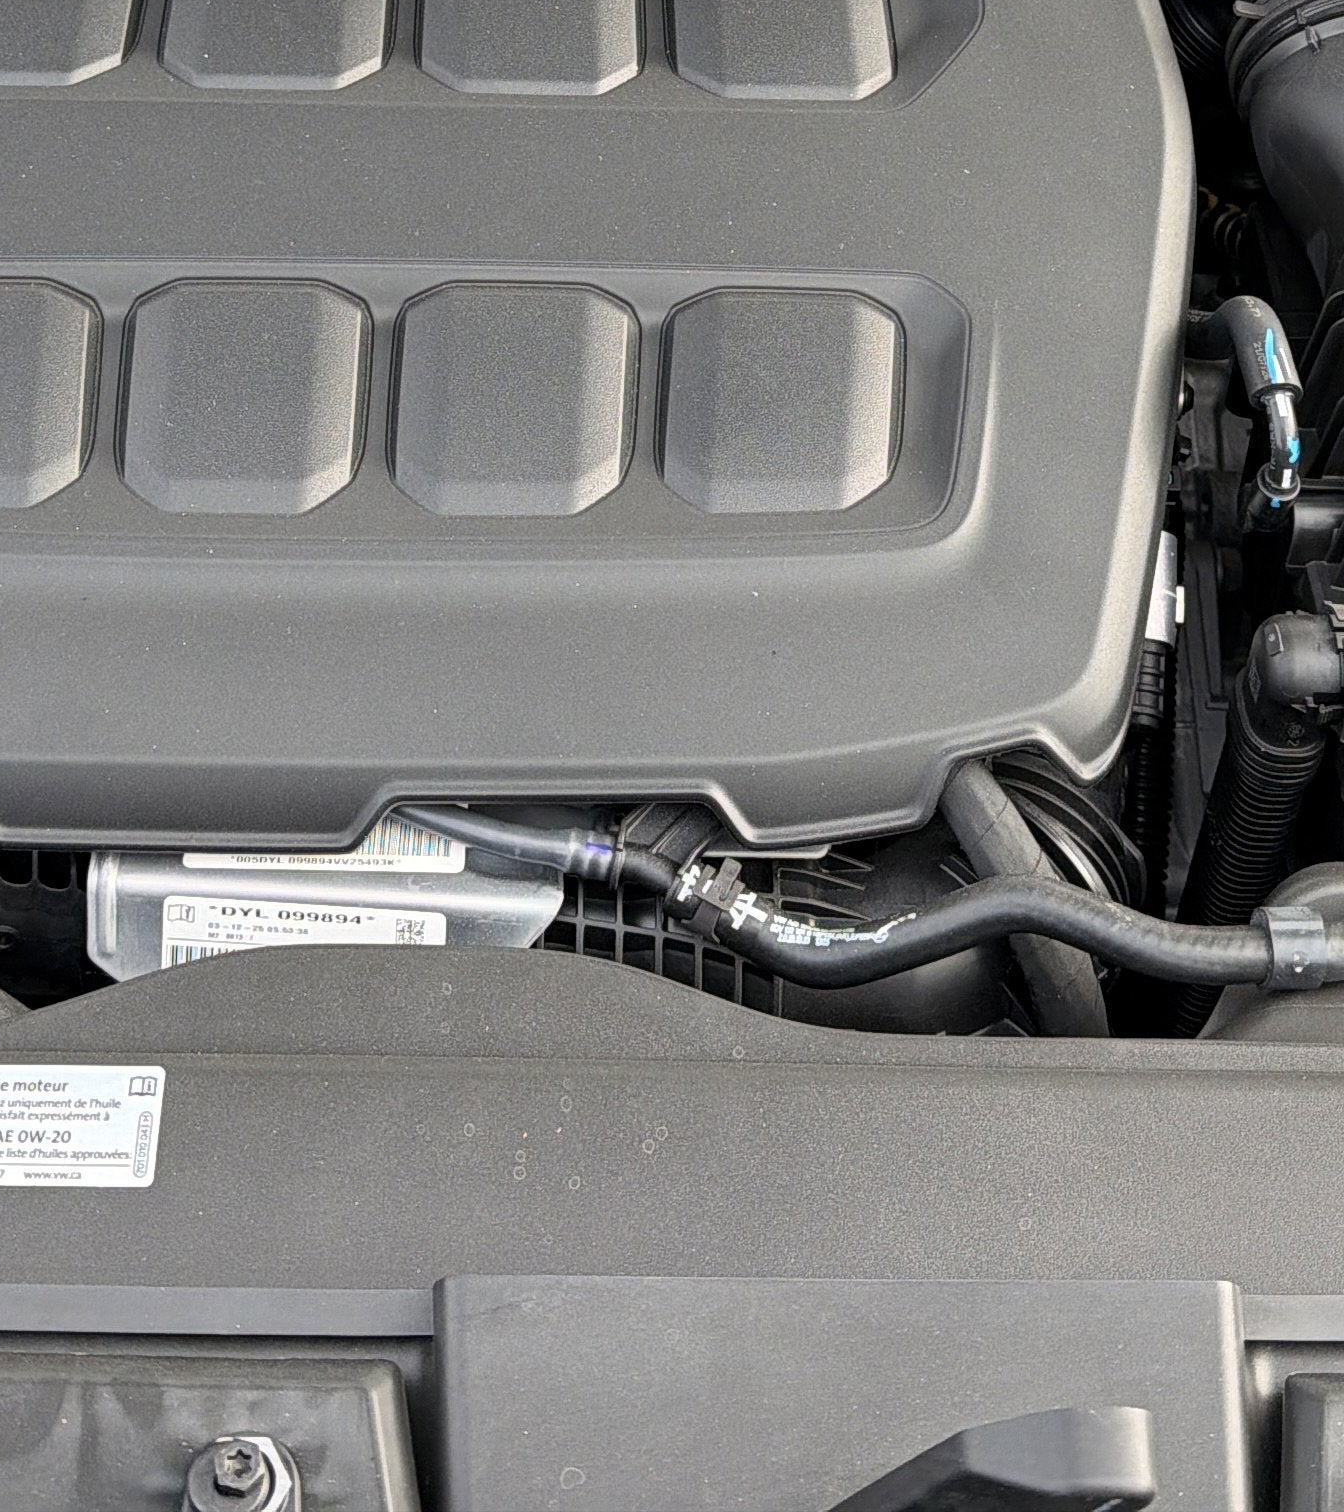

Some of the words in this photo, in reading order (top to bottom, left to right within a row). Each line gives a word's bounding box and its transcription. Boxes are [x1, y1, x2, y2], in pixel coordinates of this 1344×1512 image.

[13, 1079, 69, 1092] moteur
[8, 1098, 72, 1111] uniquement
[74, 1099, 87, 1108] de
[28, 1111, 101, 1122] expressément
[17, 1130, 72, 1143] 0W-20
[6, 1148, 27, 1158] liste
[29, 1148, 68, 1159] d'huiles
[24, 1171, 82, 1180] www.vw.ca
